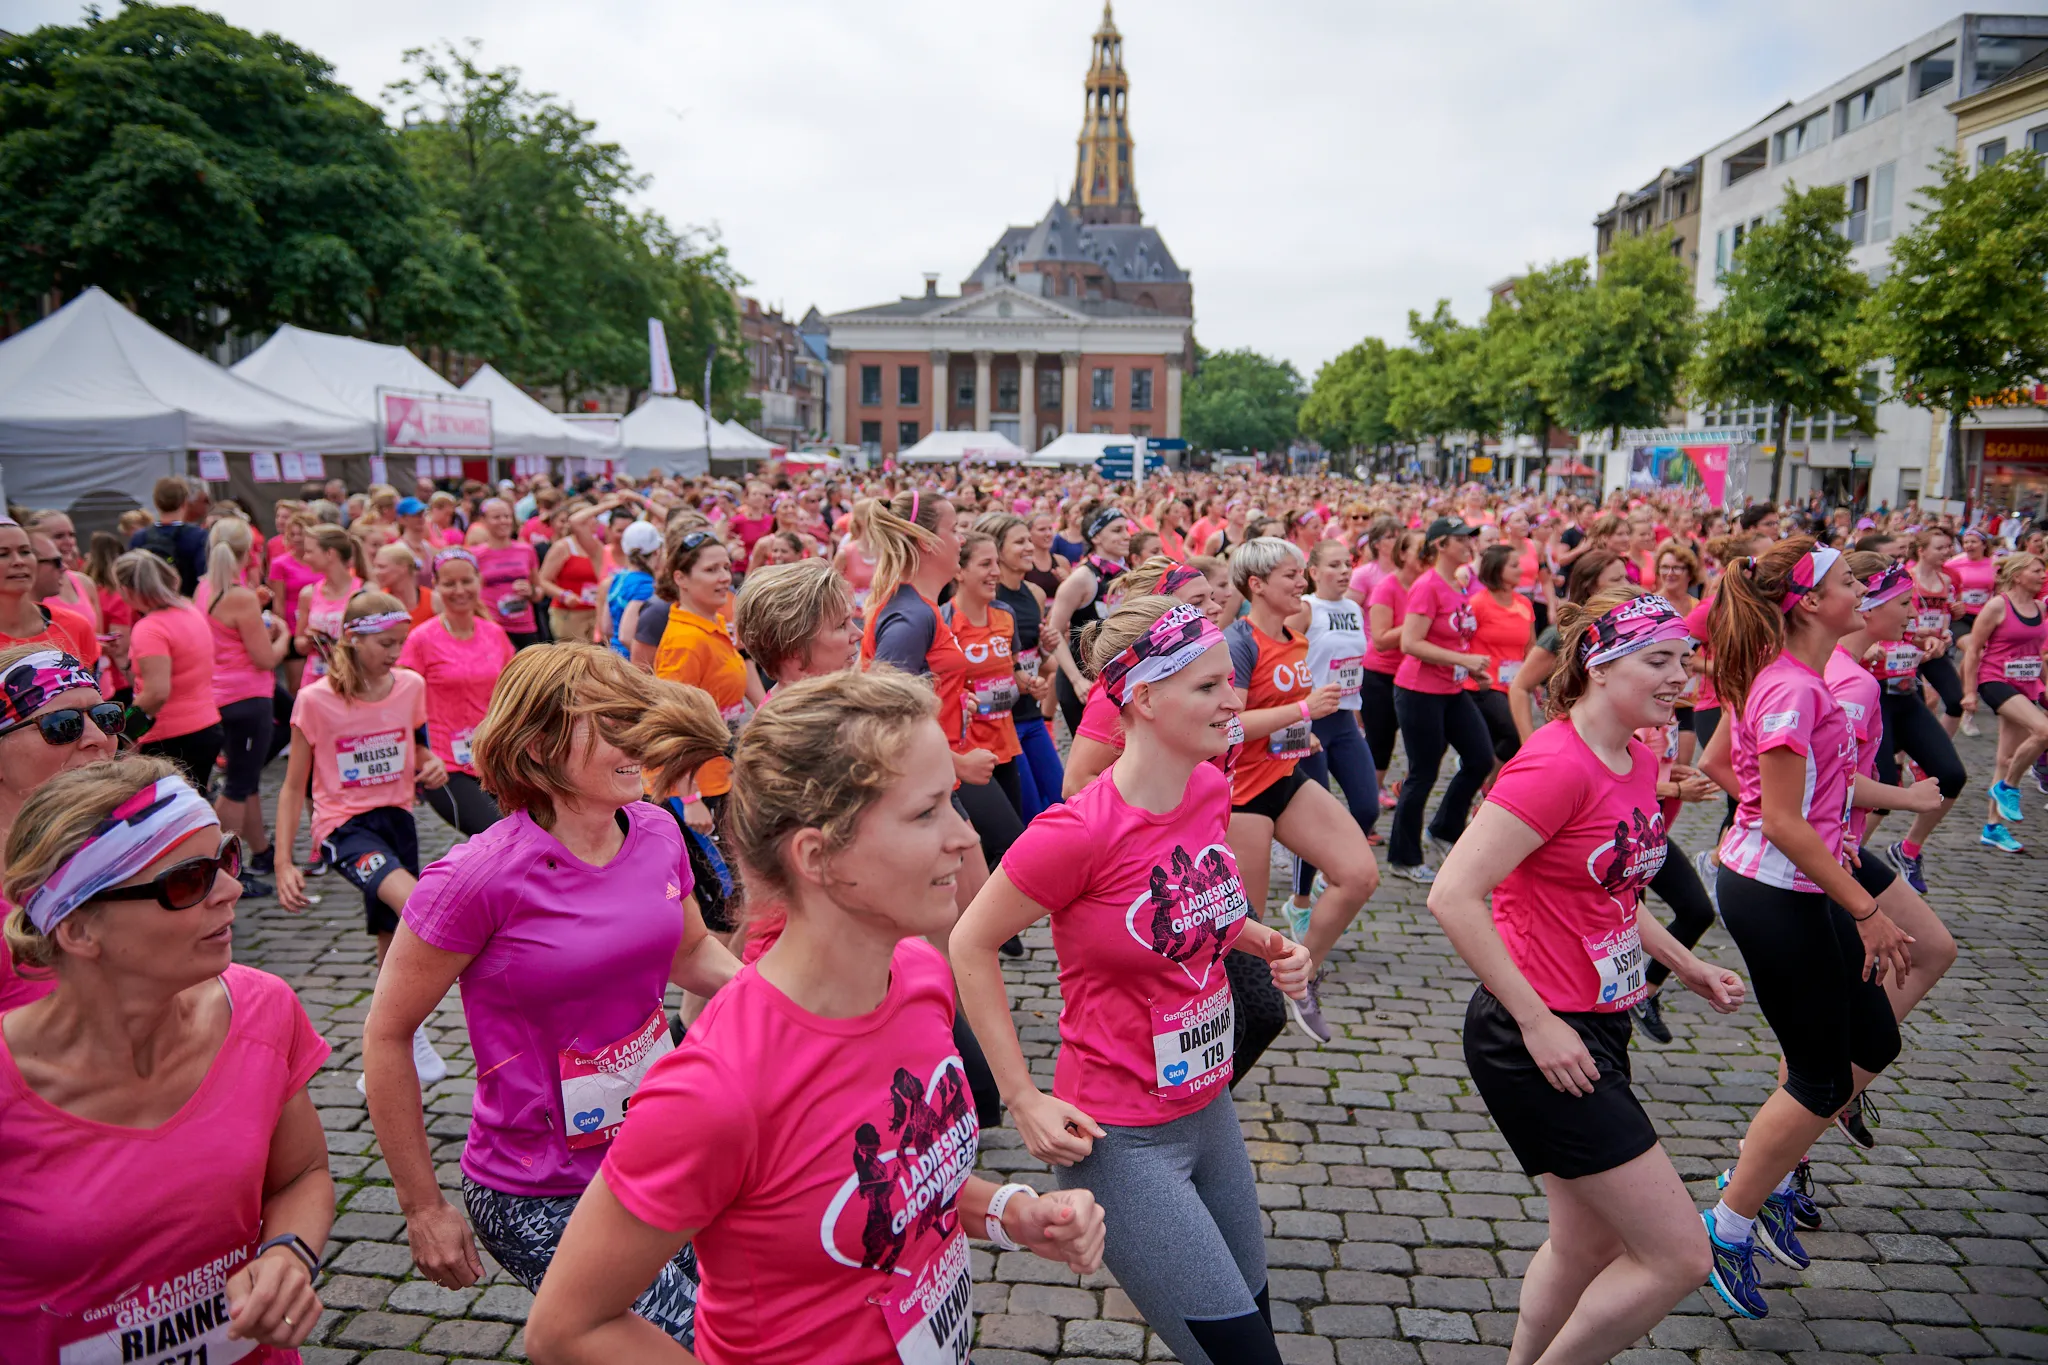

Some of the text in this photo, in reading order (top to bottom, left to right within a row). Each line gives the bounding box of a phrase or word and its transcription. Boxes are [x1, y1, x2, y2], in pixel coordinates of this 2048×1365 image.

[1328, 612, 1360, 631] NIKE
[354, 745, 399, 764] MELISSA
[368, 761, 391, 775] 603
[1171, 888, 1245, 934] GRONINGEN
[1179, 875, 1241, 915] LADIESRUN
[1626, 969, 1641, 992] 110
[1163, 1009, 1194, 1022] GasTerra
[1179, 1007, 1231, 1054] DAGMAR
[597, 1034, 655, 1074] GRONINGEN
[614, 1014, 661, 1060] LADIESRUN
[1201, 1041, 1225, 1070] 179
[1169, 1068, 1185, 1080] 5KM
[579, 1115, 599, 1127] 5KM
[899, 1106, 979, 1200] LADIESRUN
[83, 1245, 248, 1323] GasTerra LADIESRUN
[115, 1271, 228, 1329] GRONINGEN
[899, 1280, 932, 1314] GasTerra
[121, 1292, 231, 1364] RIANNE
